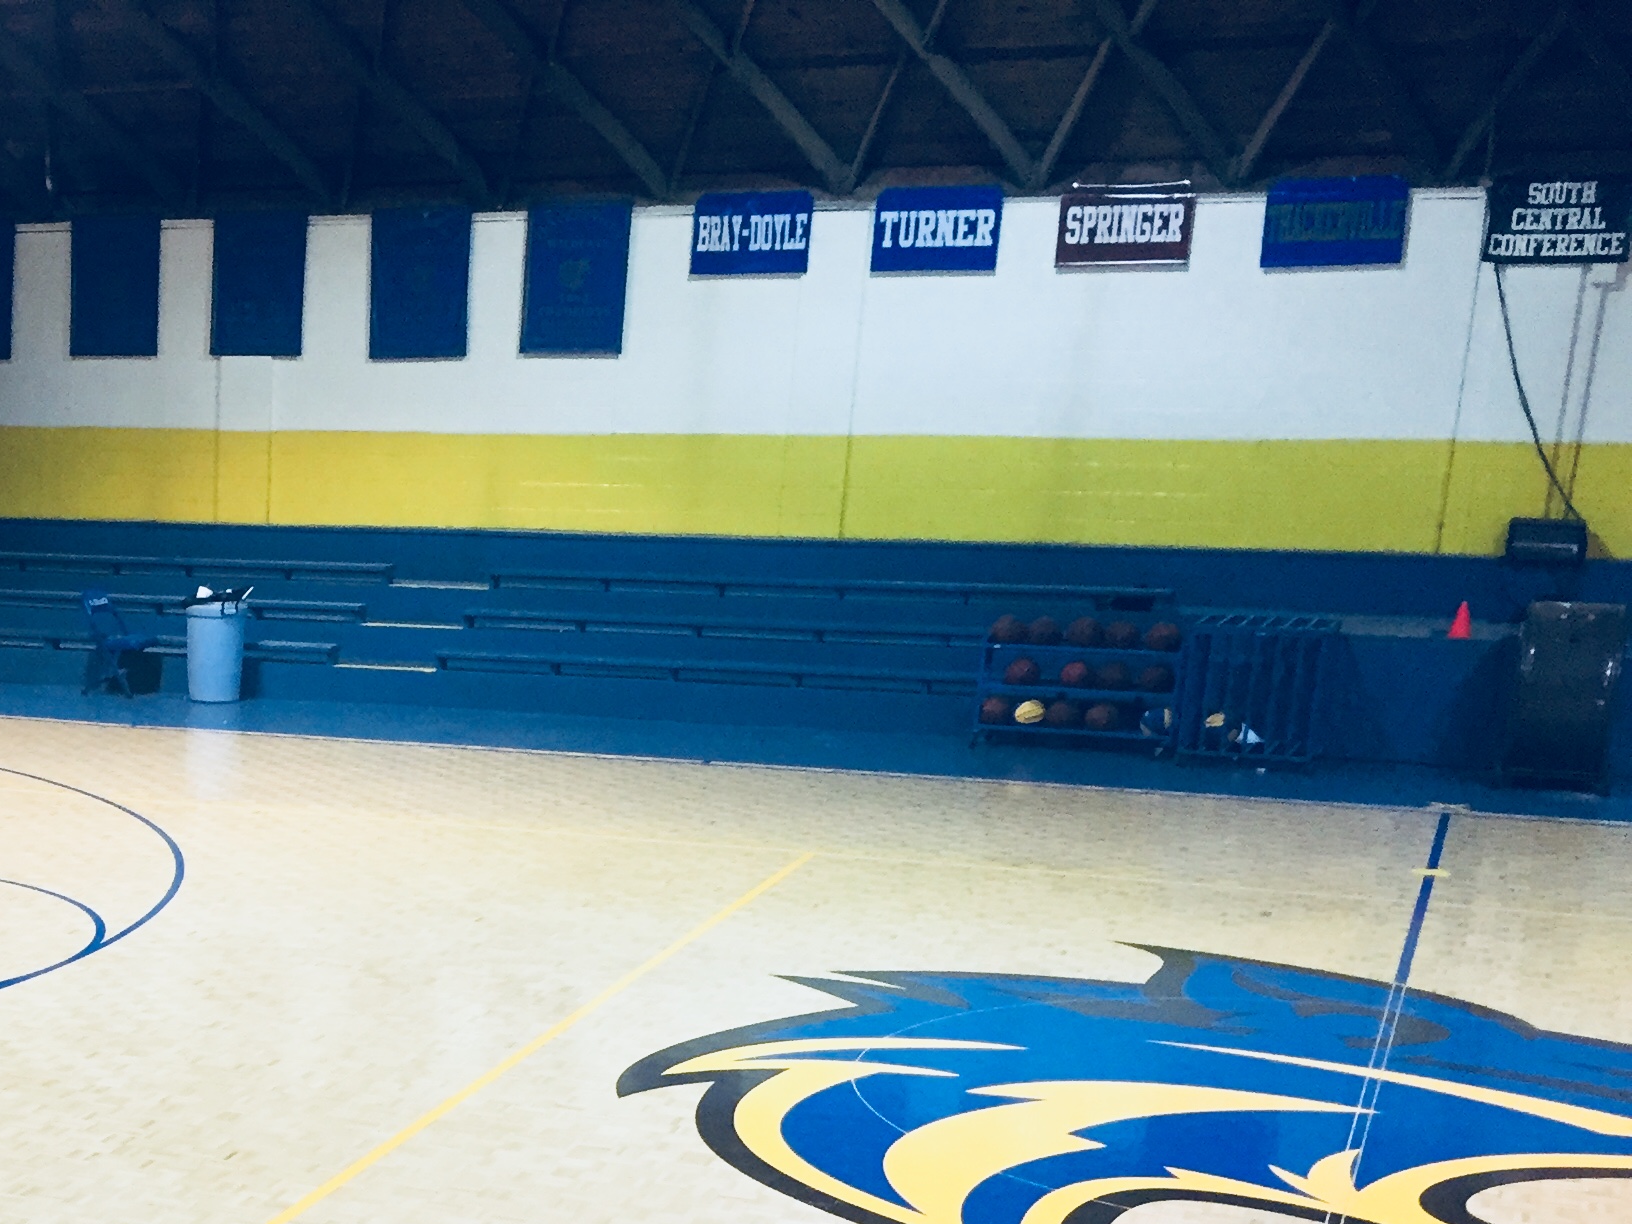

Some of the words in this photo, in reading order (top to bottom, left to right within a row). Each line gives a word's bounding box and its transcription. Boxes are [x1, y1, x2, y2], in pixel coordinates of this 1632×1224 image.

[1528, 181, 1598, 205] SOUTH
[696, 213, 808, 252] BRAY-DOYLE
[879, 208, 996, 249] TURNER
[1064, 203, 1185, 244] SPRINGER
[1511, 207, 1606, 231] CENTRAL
[1488, 232, 1626, 257] CONFERENCE
